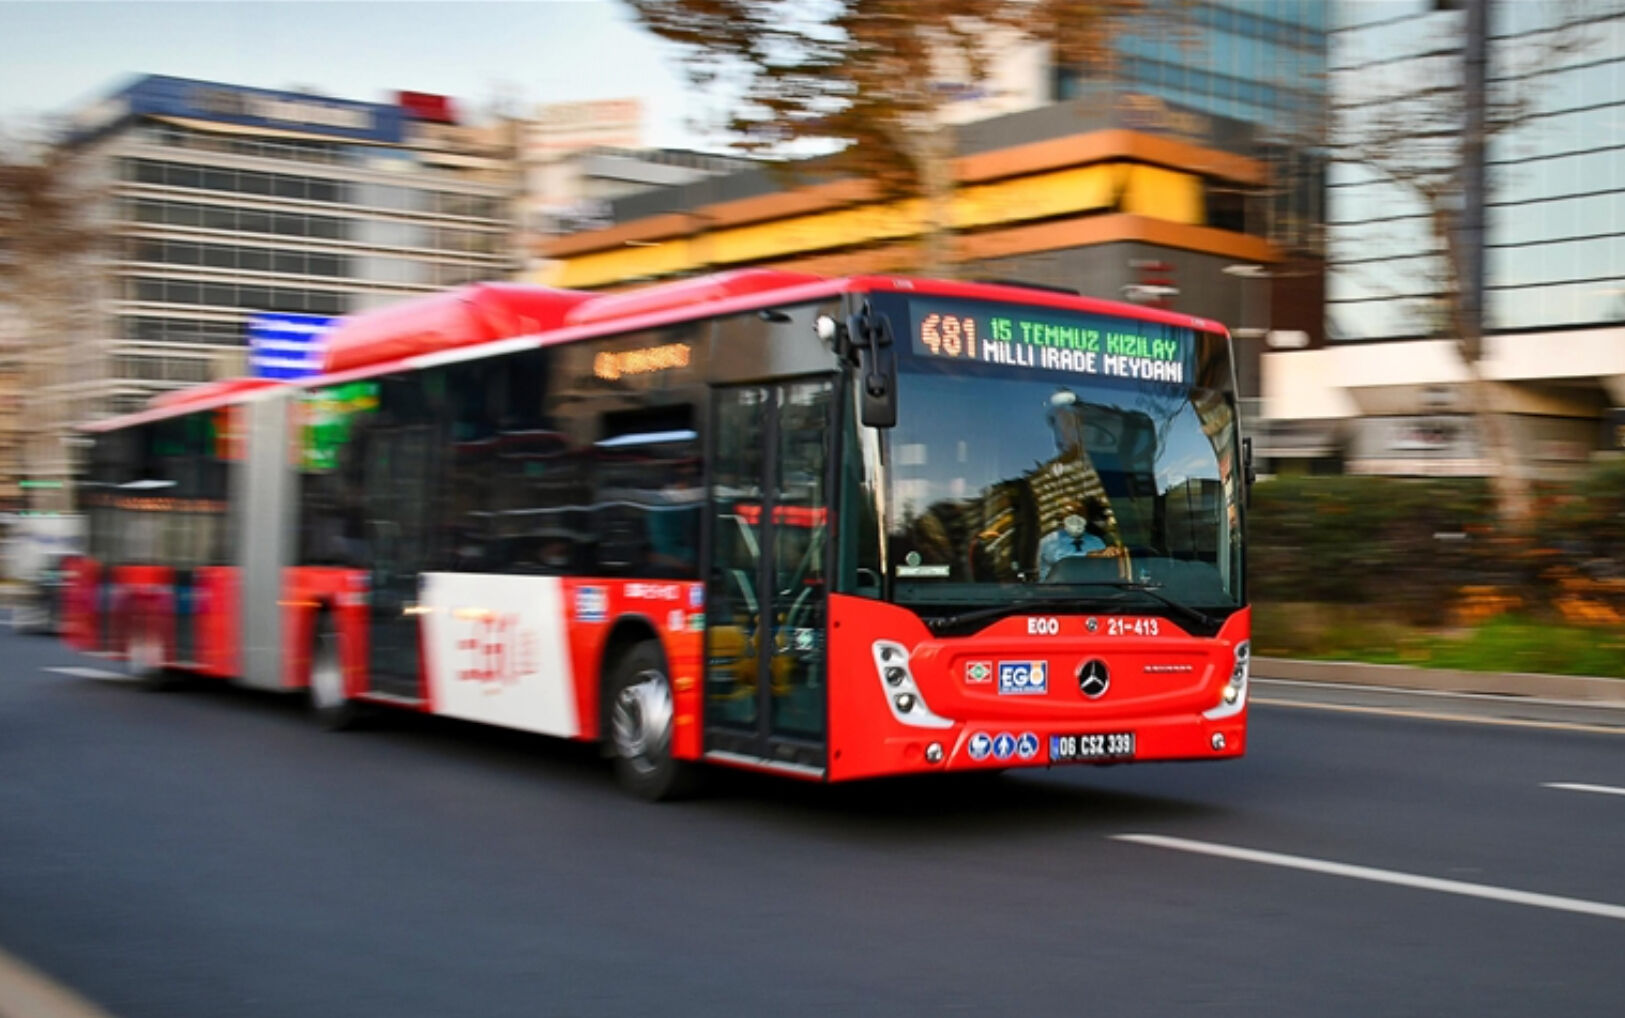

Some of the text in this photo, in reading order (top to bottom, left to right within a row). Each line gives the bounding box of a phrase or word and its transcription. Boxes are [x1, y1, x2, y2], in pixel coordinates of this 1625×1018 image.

[921, 313, 976, 358] 481
[990, 318, 1177, 361] 15 TEMMUZ KIZILAY
[1103, 353, 1184, 384] MEYDANI
[1027, 617, 1159, 636] EGO 21-413
[1001, 666, 1045, 687] EGO
[1060, 736, 1076, 756] 06
[1081, 734, 1104, 755] CSZ
